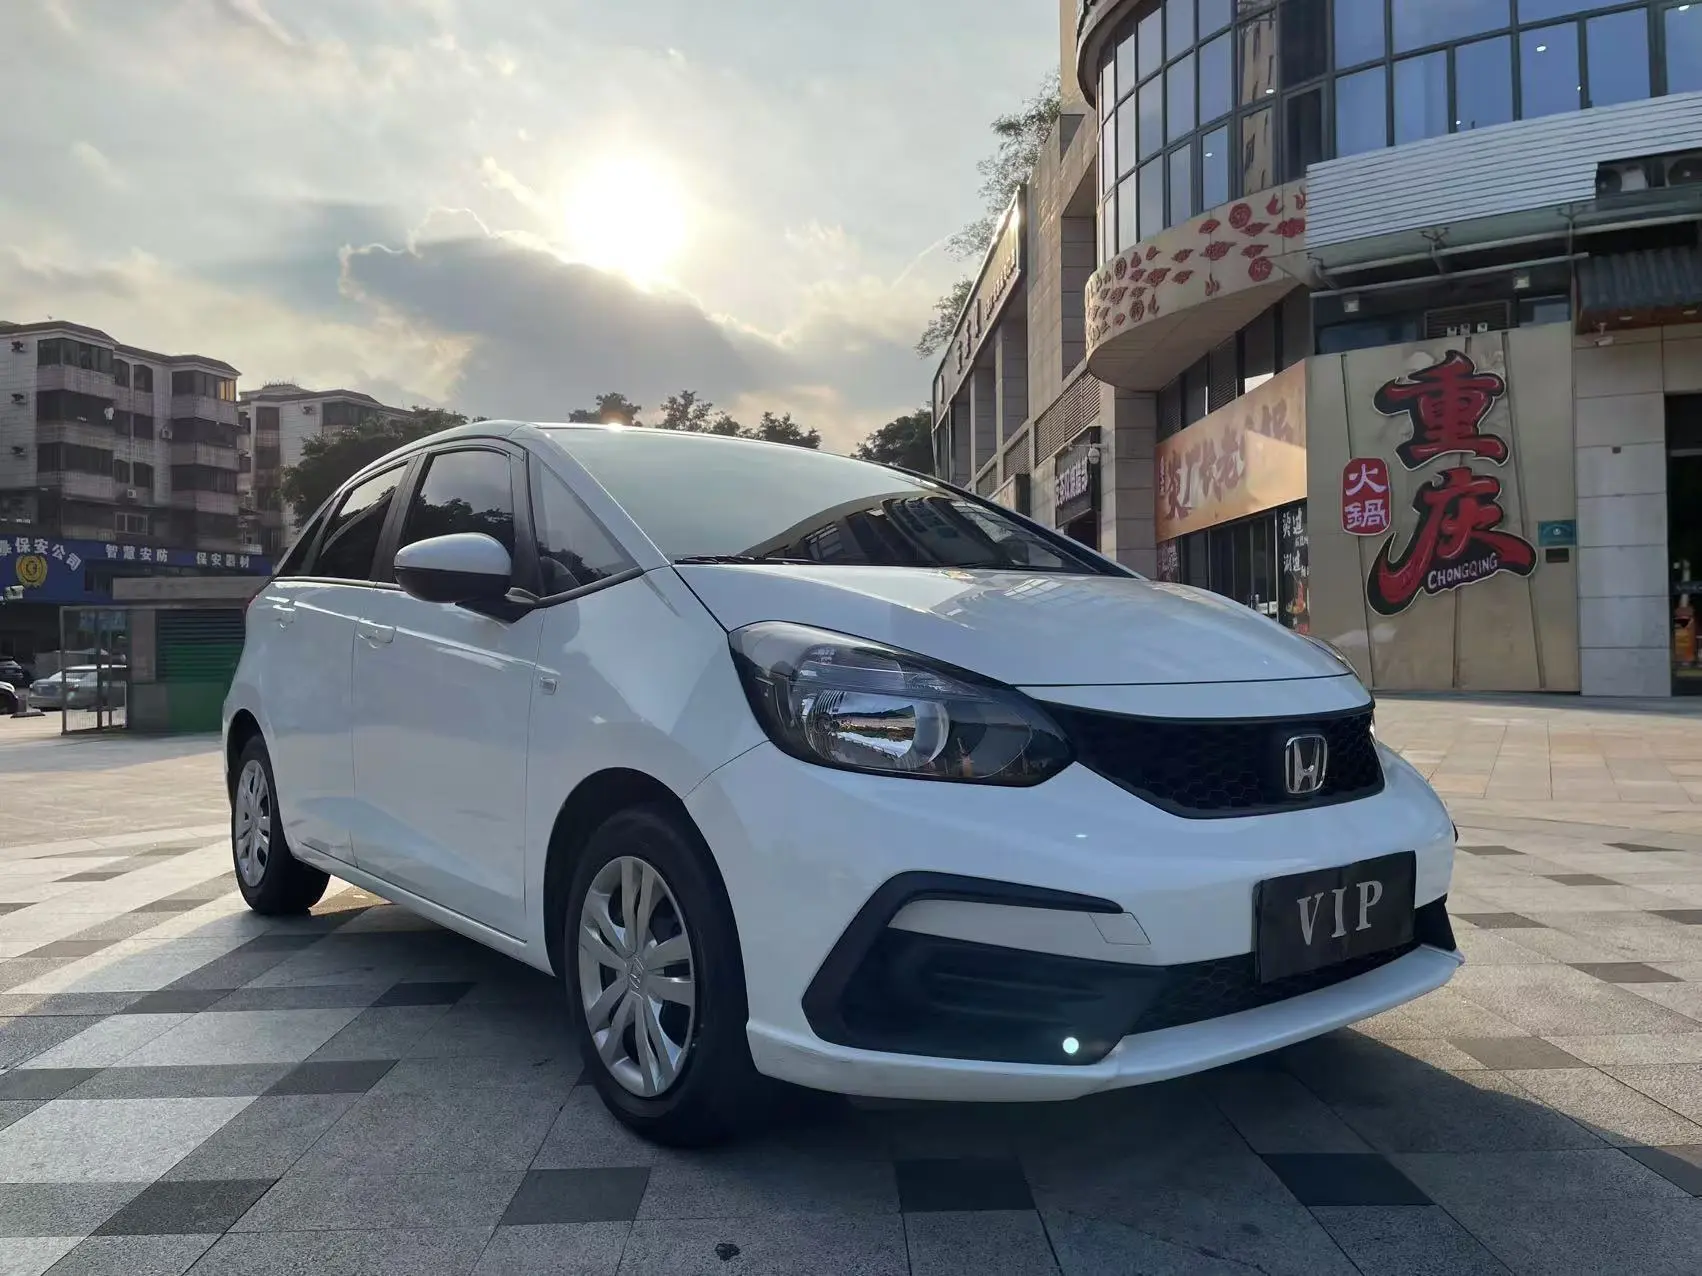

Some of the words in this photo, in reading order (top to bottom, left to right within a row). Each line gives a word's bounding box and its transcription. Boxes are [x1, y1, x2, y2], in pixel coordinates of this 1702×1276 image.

[1367, 350, 1536, 616] 重庆
[105, 544, 169, 562] 智慧安防
[196, 552, 250, 568] 保安器材
[1427, 552, 1498, 589] CHONGQING
[1297, 879, 1383, 946] VIP
